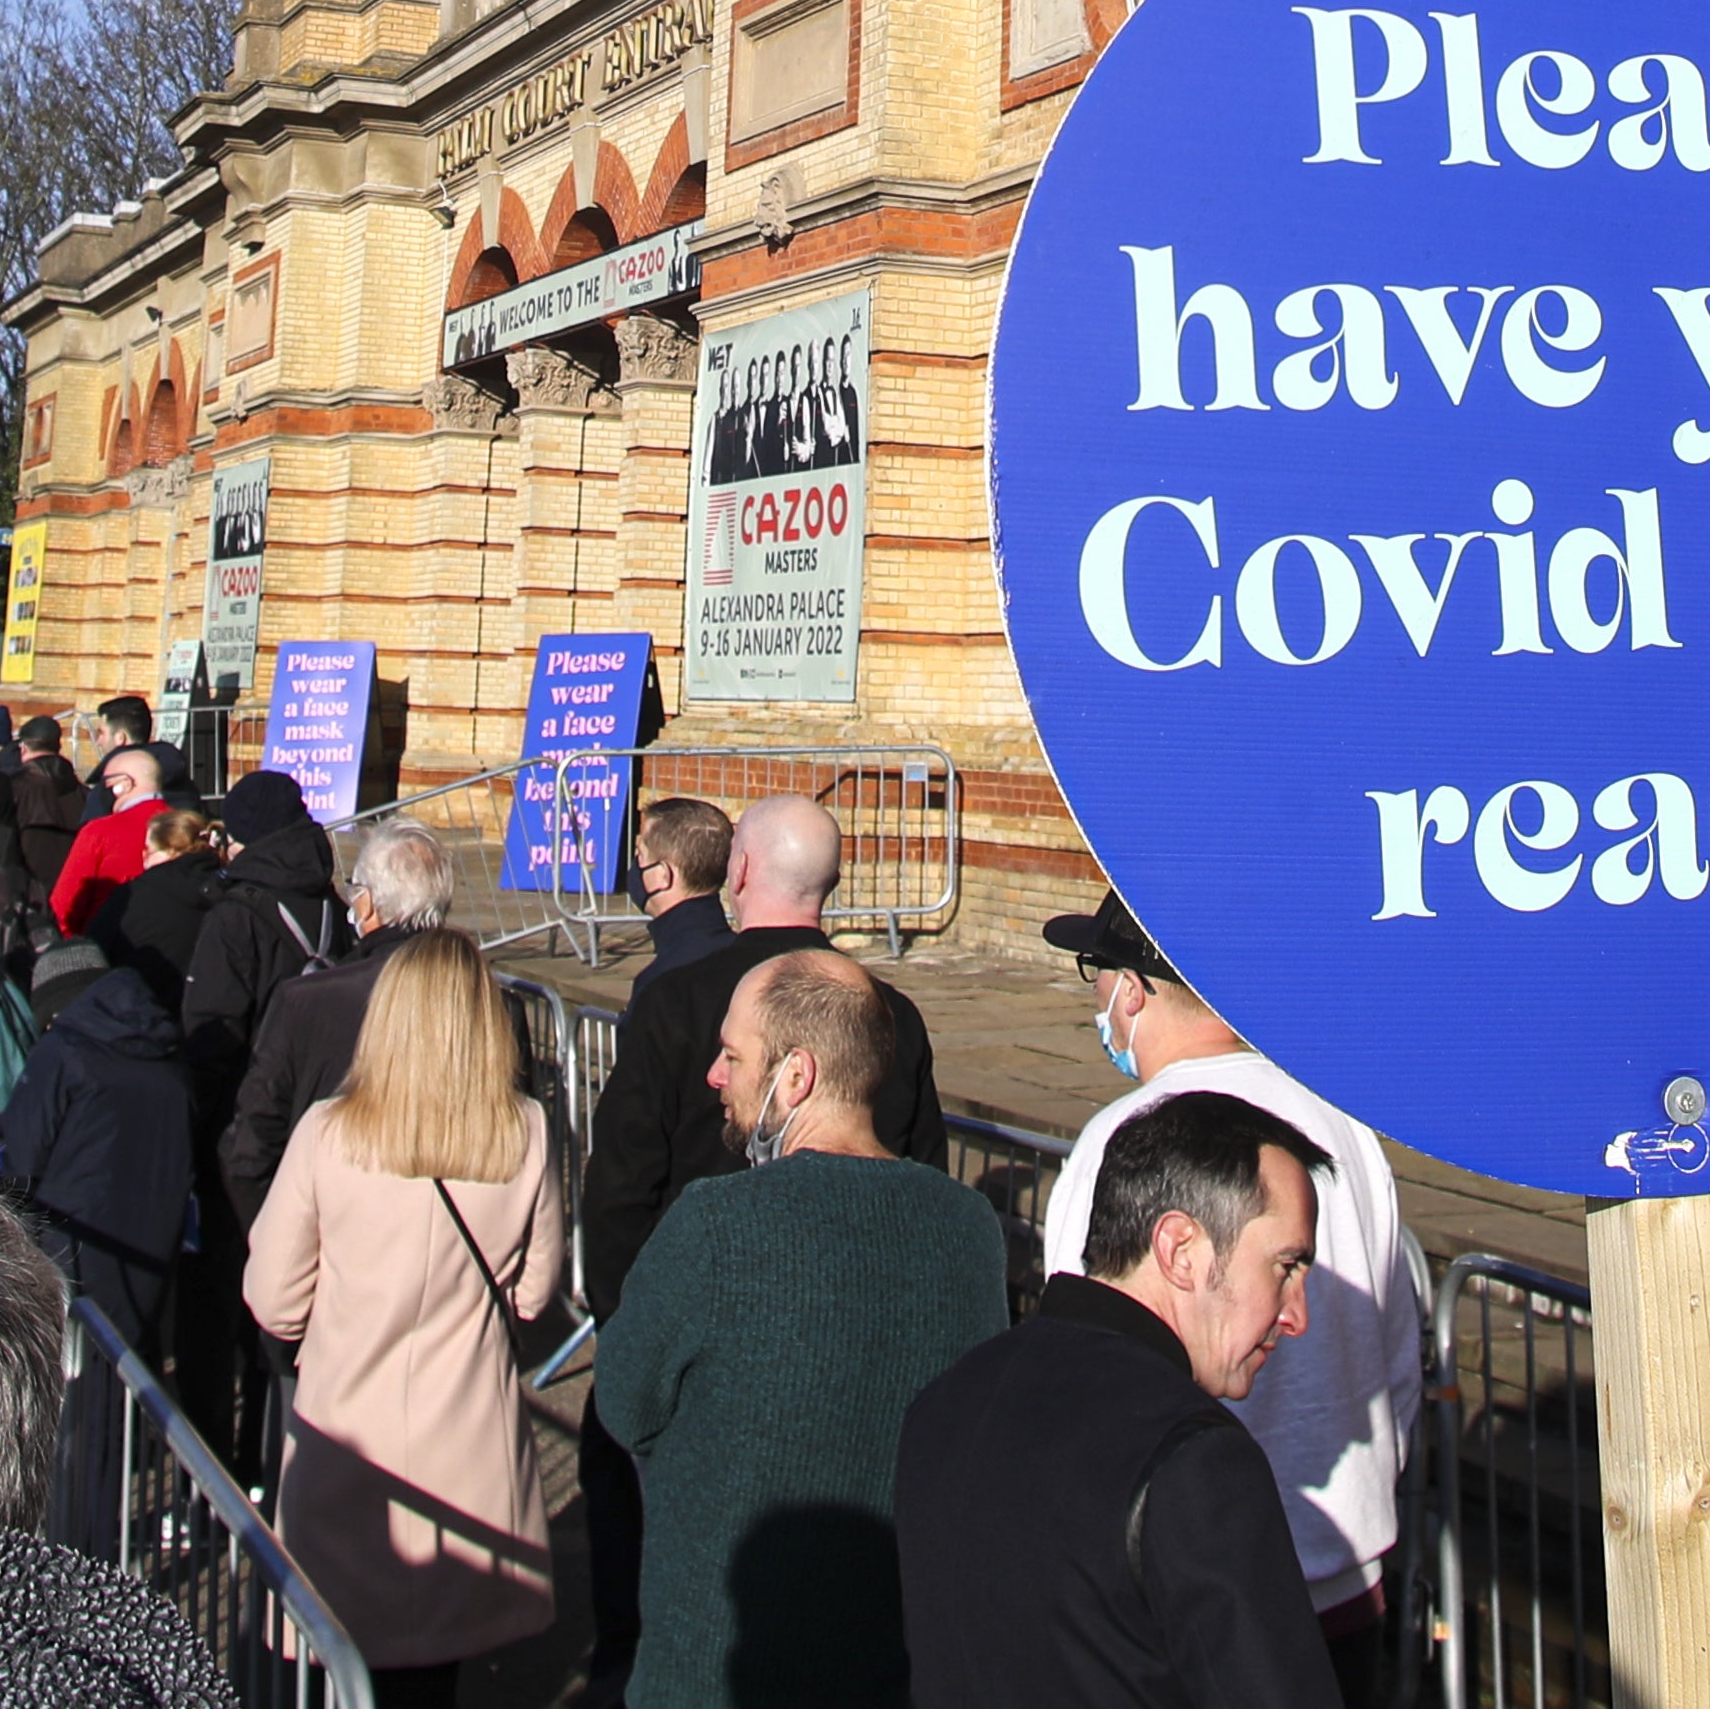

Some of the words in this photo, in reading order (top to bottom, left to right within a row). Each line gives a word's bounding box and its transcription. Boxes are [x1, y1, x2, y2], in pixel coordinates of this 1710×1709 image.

[437, 105, 493, 178] PALM
[501, 48, 591, 144] COURT
[618, 246, 665, 284] CAZOO
[628, 279, 654, 297] MASTERS
[499, 292, 554, 335] WELCOME
[557, 286, 573, 310] TO
[577, 275, 600, 309] THE
[1120, 246, 1605, 410] have
[741, 483, 848, 545] CAZOO
[765, 548, 818, 574] MASTERS
[222, 566, 258, 597] CAZOO
[1080, 480, 1682, 670] Covid
[700, 593, 785, 623] ALEXANDRA
[790, 589, 845, 621] PALACE
[701, 630, 729, 657] 9-16
[734, 627, 802, 656] JANUARY
[807, 625, 843, 654] 2022
[286, 654, 355, 672] Please
[546, 651, 626, 676] Please
[291, 678, 347, 693] wear
[551, 683, 614, 705] wear
[283, 702, 298, 718] a
[303, 698, 349, 716] face
[285, 722, 344, 740] mask
[541, 718, 557, 738] a
[563, 711, 616, 736] face
[272, 744, 354, 770] beyond
[301, 790, 336, 810] int
[524, 773, 619, 804] beond
